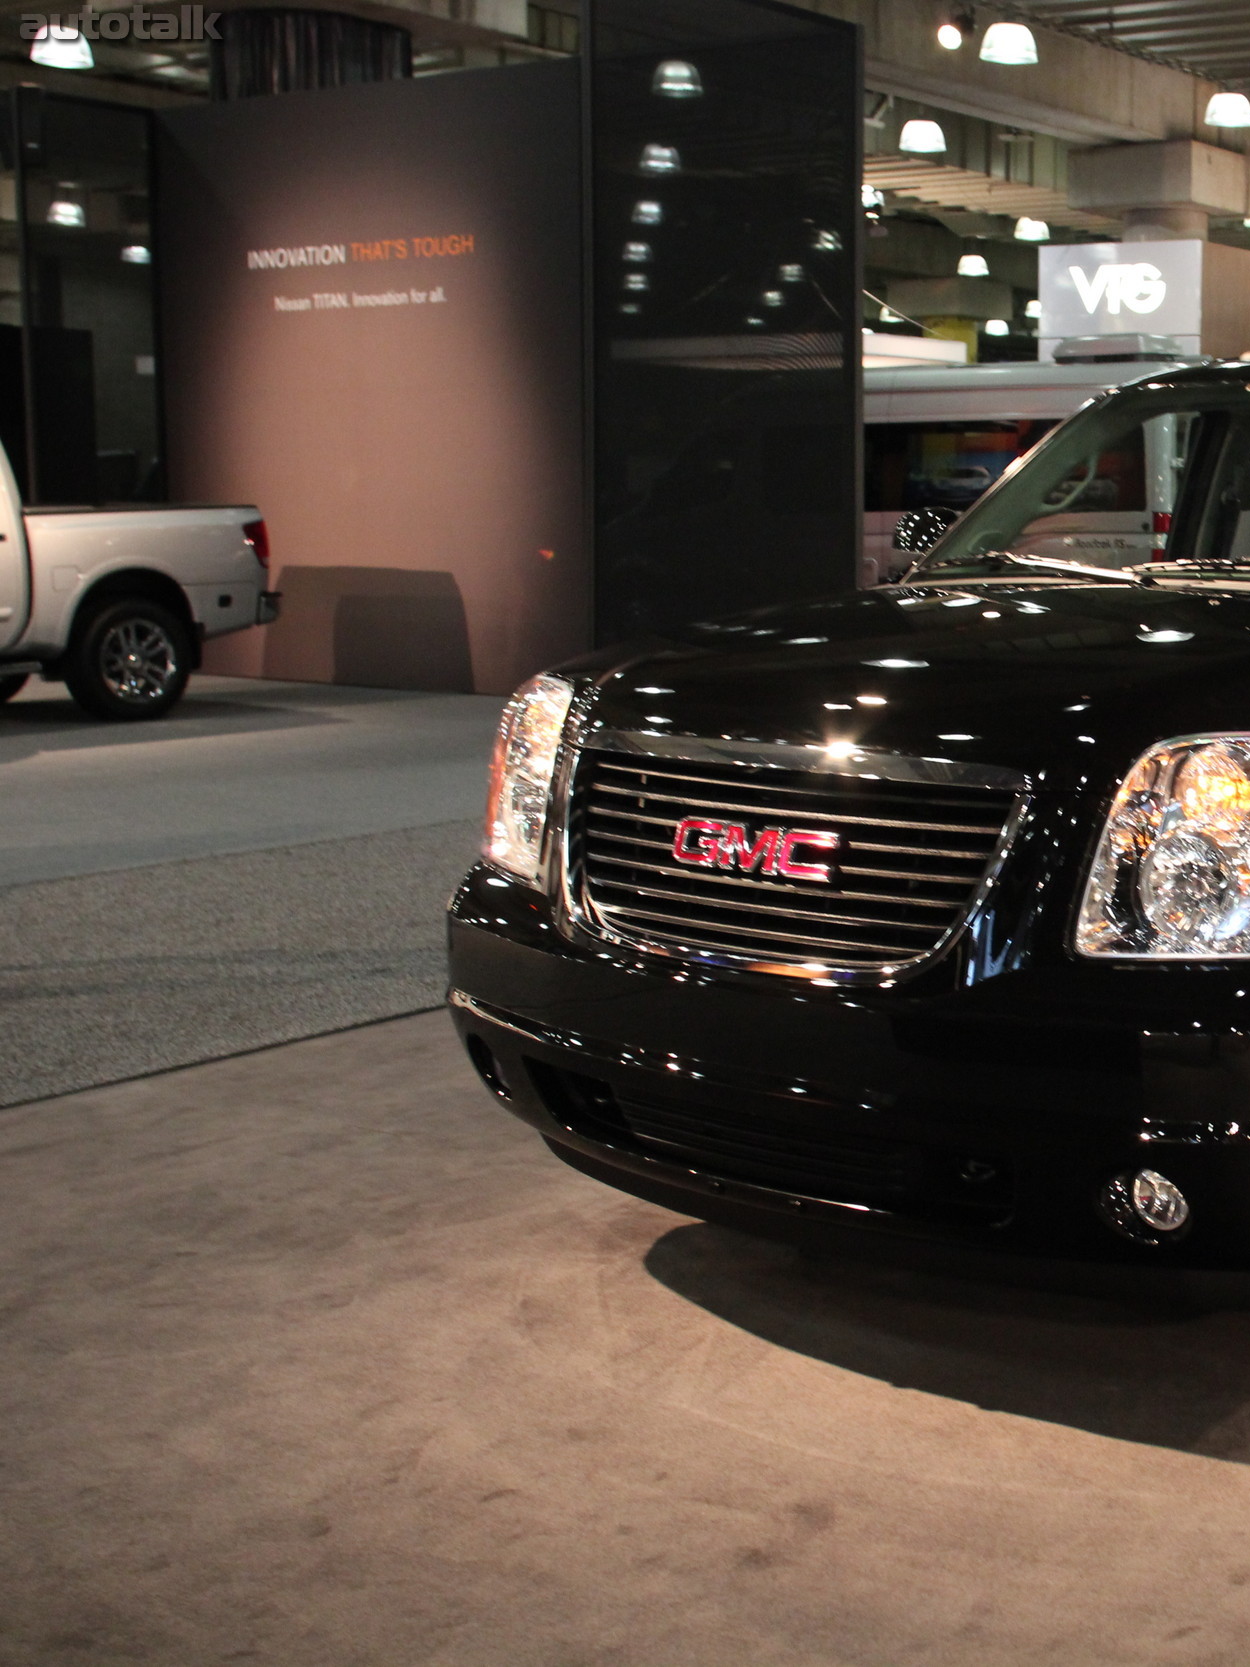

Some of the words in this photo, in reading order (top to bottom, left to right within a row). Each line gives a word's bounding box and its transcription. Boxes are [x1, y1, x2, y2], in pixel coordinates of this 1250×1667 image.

[248, 245, 346, 269] INNOVATION
[351, 239, 407, 261] THAT'S
[413, 235, 474, 257] TOUGH
[352, 290, 409, 306] Innovation
[410, 287, 427, 303] for
[673, 816, 840, 883] GMC
